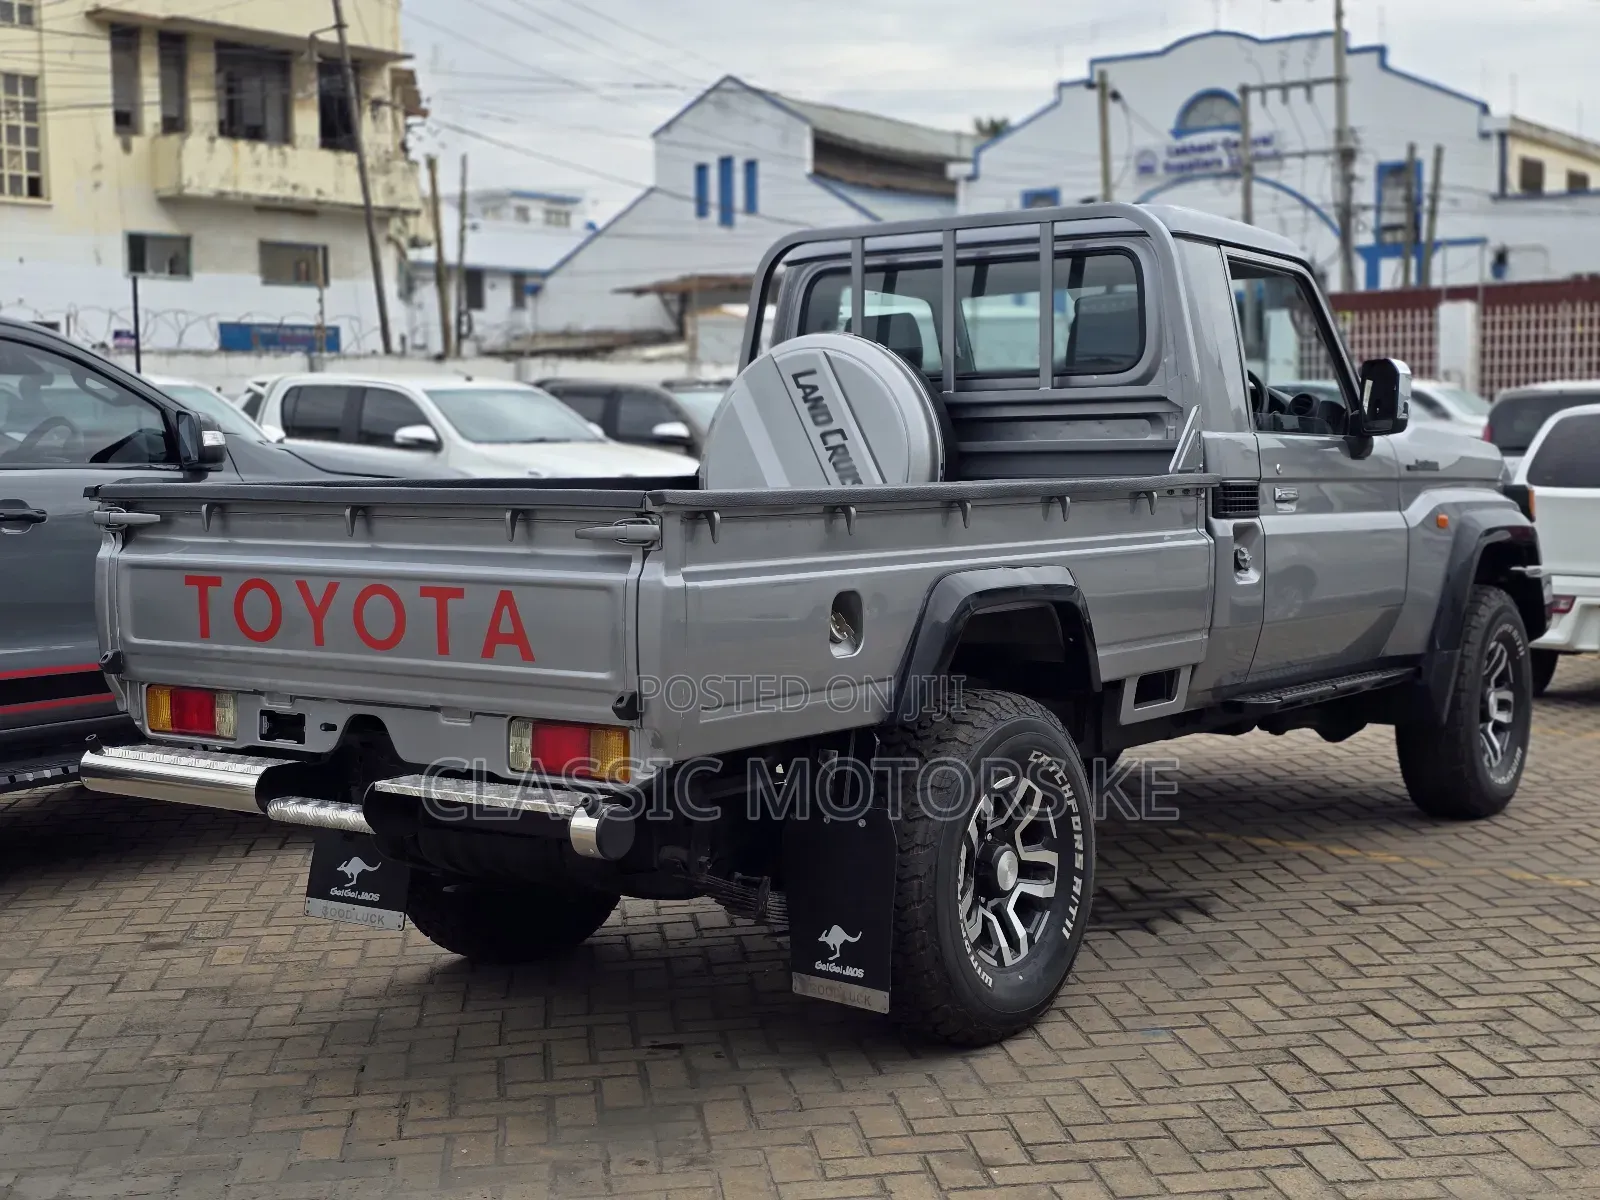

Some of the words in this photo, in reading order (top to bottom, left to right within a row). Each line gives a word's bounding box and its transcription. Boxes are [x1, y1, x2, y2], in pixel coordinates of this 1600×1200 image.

[791, 368, 834, 427] LAND
[184, 574, 536, 662] TOYOTA
[355, 912, 385, 926] LUCK
